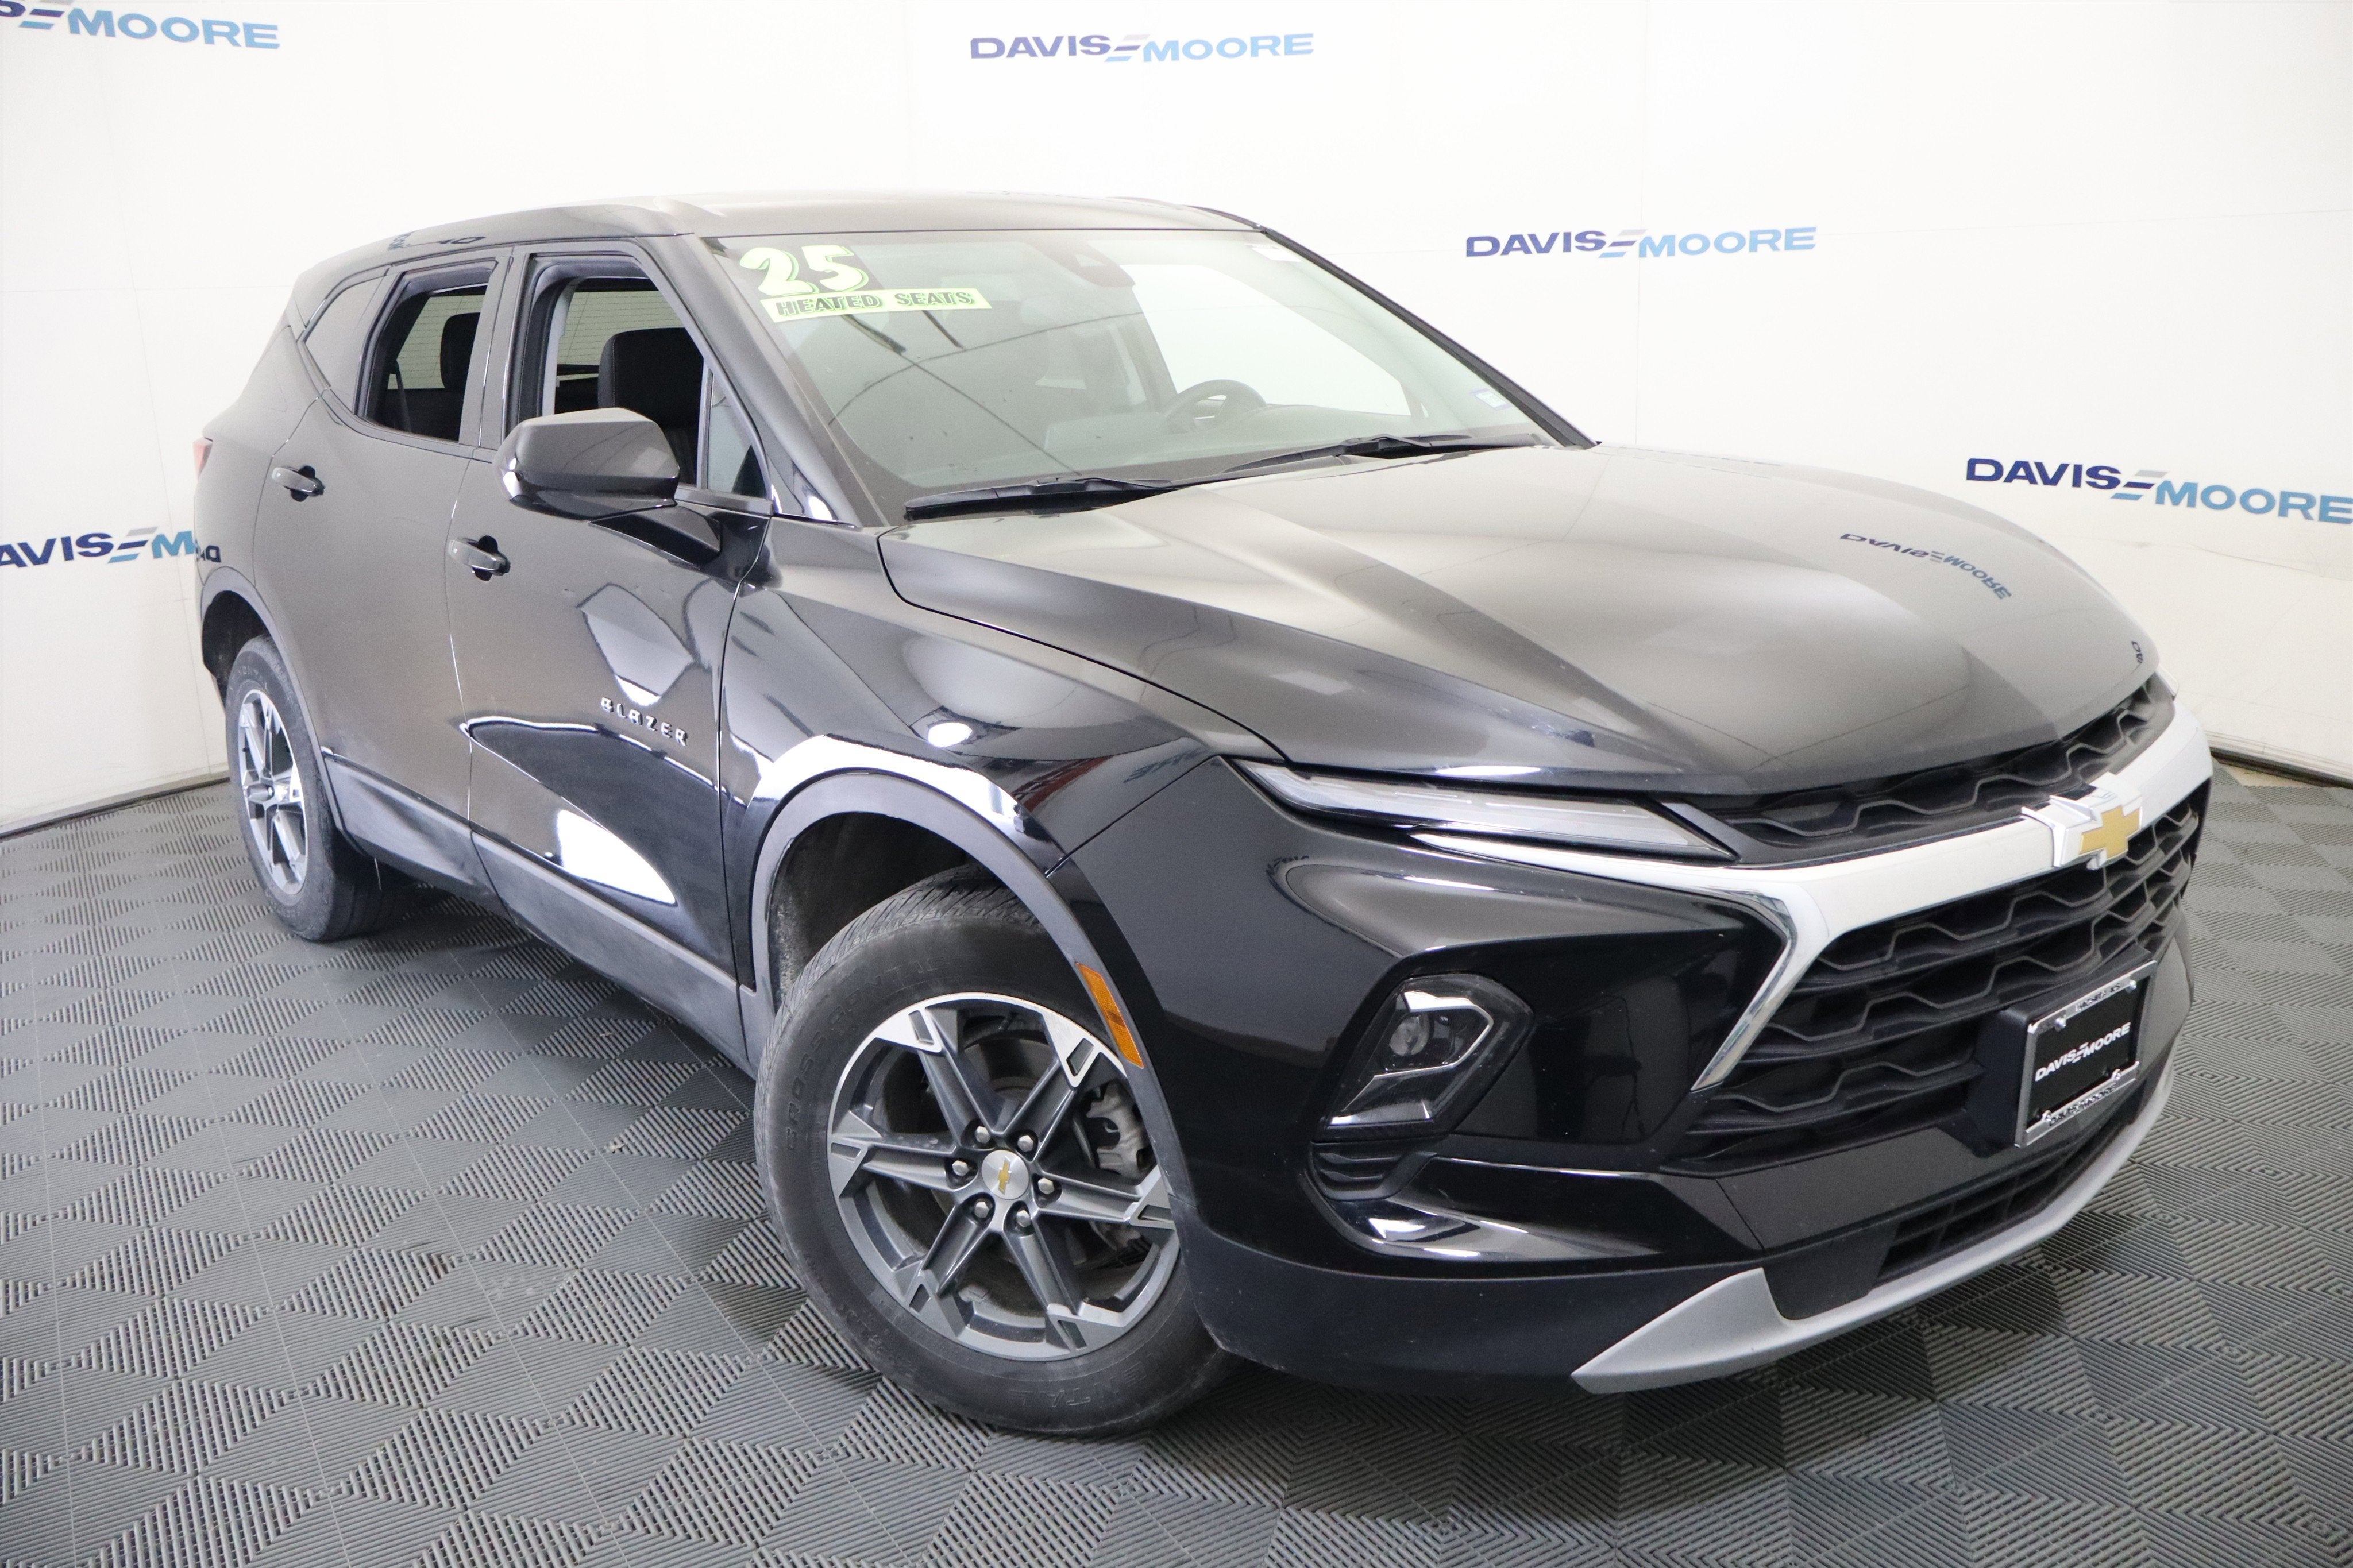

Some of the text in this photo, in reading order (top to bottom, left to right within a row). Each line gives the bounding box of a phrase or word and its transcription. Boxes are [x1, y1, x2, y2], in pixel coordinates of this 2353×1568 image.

[67, 7, 281, 49] MOORE
[970, 33, 1314, 62] DAVIS MOORE
[1466, 227, 1817, 258] DAVIS MOORE
[740, 245, 869, 297] 25
[776, 291, 975, 316] HEATED SEATS
[1966, 457, 2353, 525] DAVIS MOORE
[0, 532, 114, 568] AVIS
[600, 697, 688, 747] BLAZER
[2035, 1021, 2131, 1082] DAVIS MOORE
